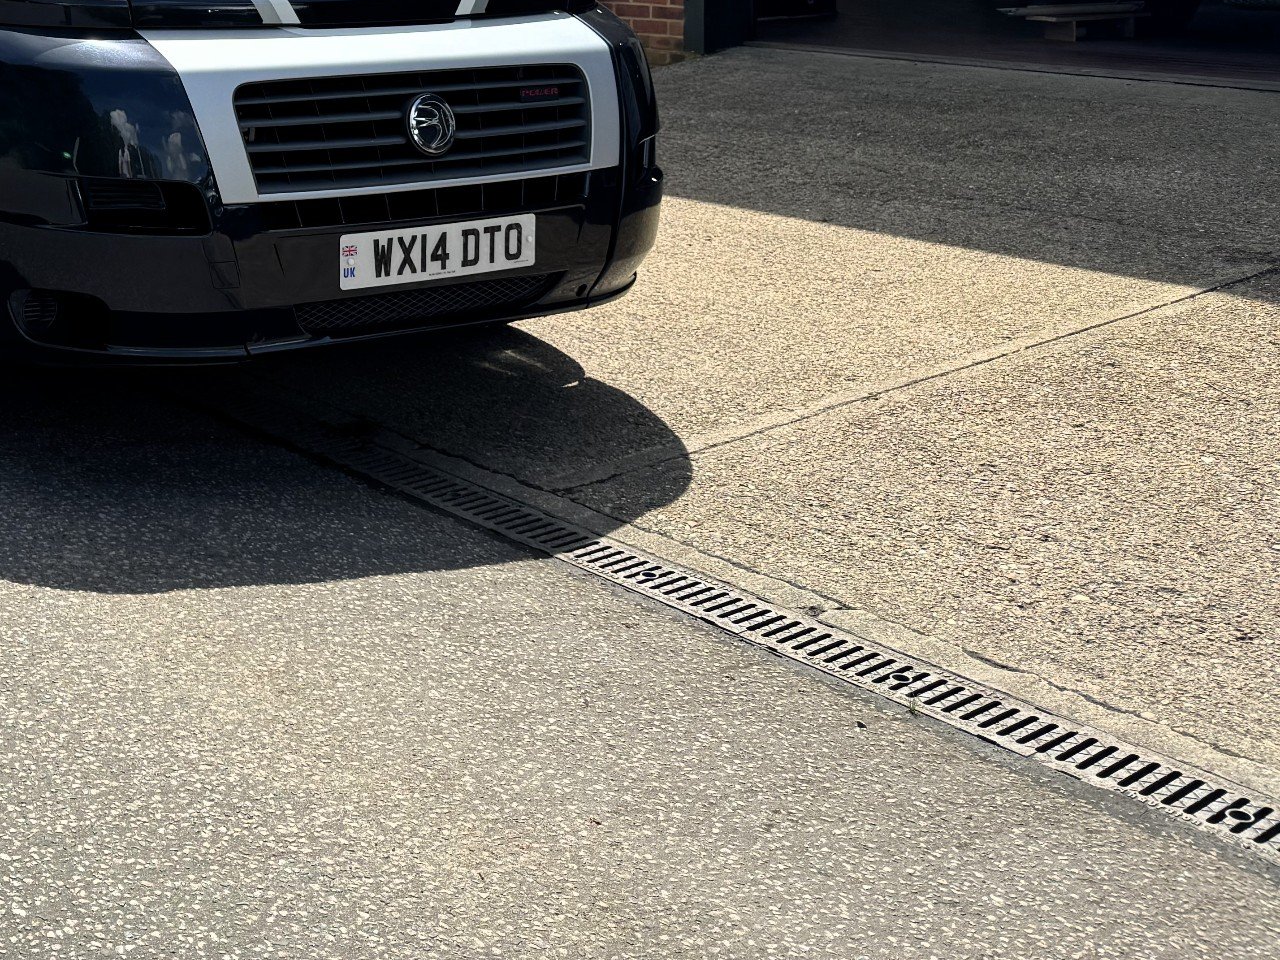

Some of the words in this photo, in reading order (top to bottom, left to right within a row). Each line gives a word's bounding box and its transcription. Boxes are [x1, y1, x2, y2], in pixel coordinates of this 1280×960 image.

[373, 231, 450, 279] WX14
[461, 222, 523, 268] DTO
[343, 267, 356, 279] UK
